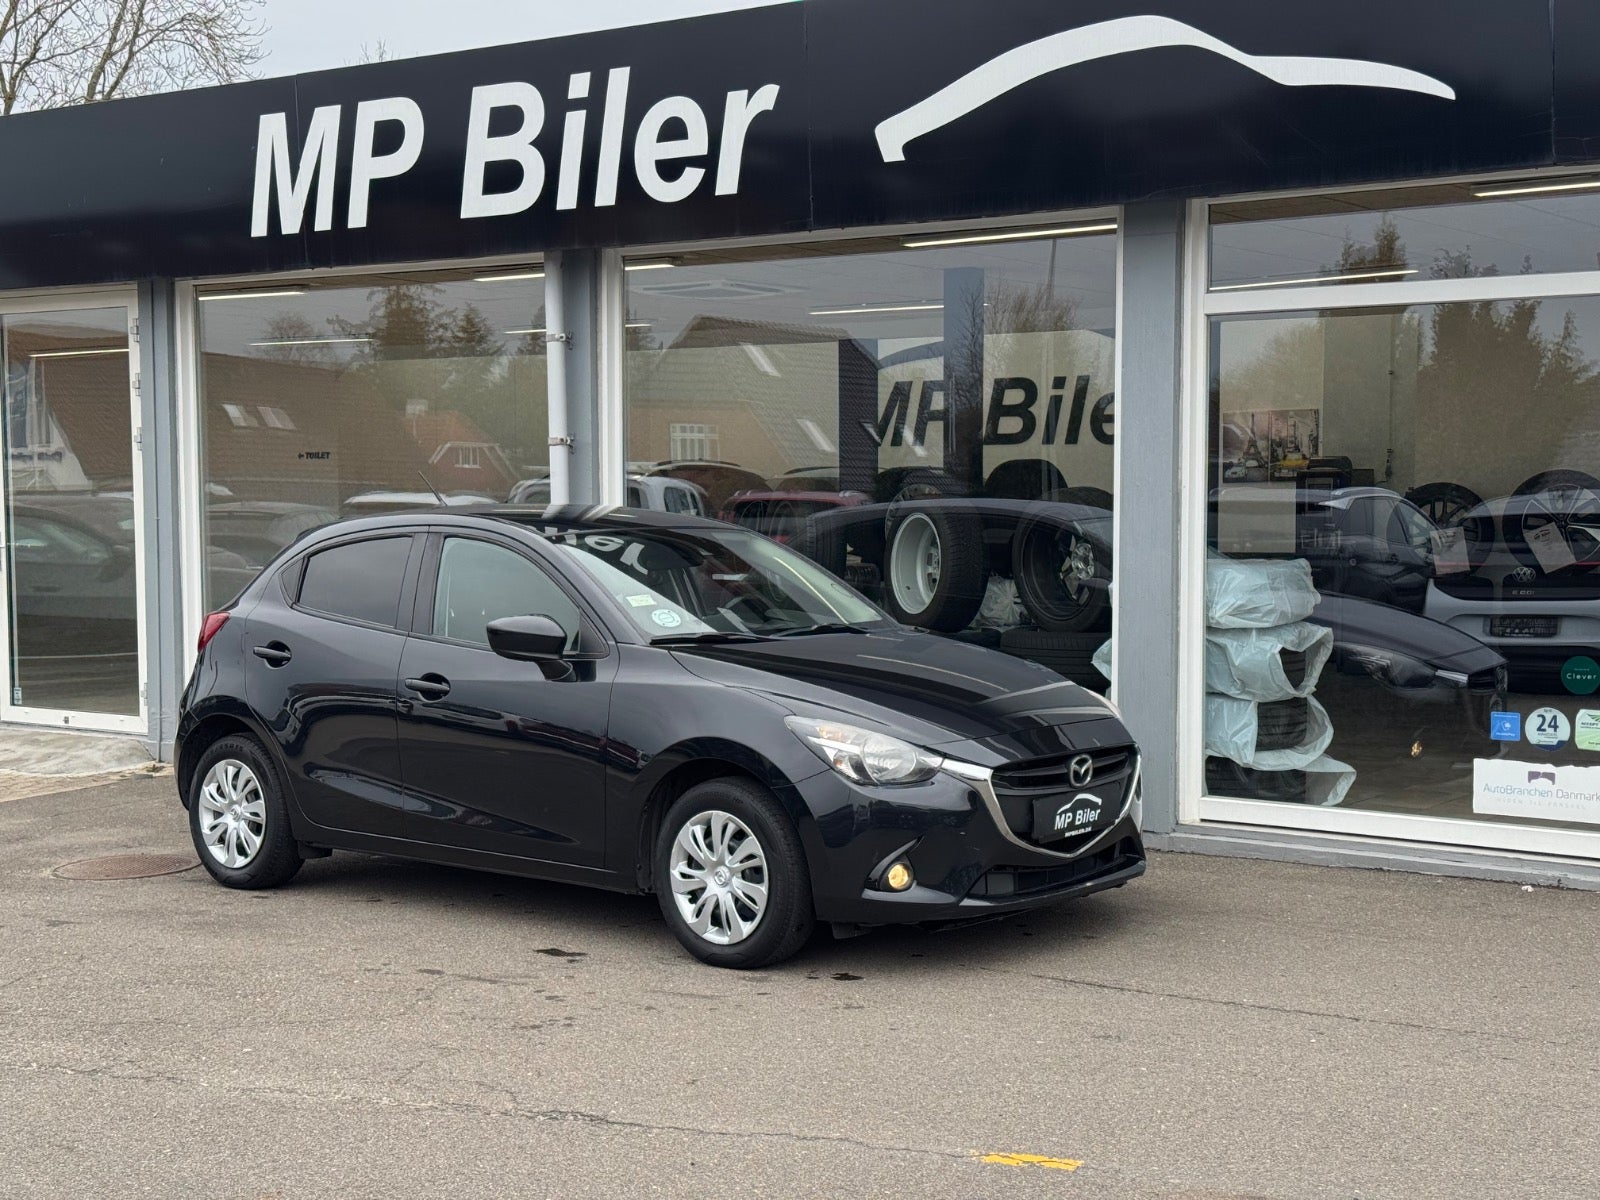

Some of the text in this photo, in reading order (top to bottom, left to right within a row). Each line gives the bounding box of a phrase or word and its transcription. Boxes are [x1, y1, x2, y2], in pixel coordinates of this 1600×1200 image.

[250, 66, 781, 238] MP Biler
[304, 451, 331, 460] TOILET
[1566, 672, 1597, 680] Clever
[1536, 713, 1559, 733] 24
[1483, 783, 1600, 802] AutoBranchen Danmark
[1054, 808, 1101, 831] MP Biler
